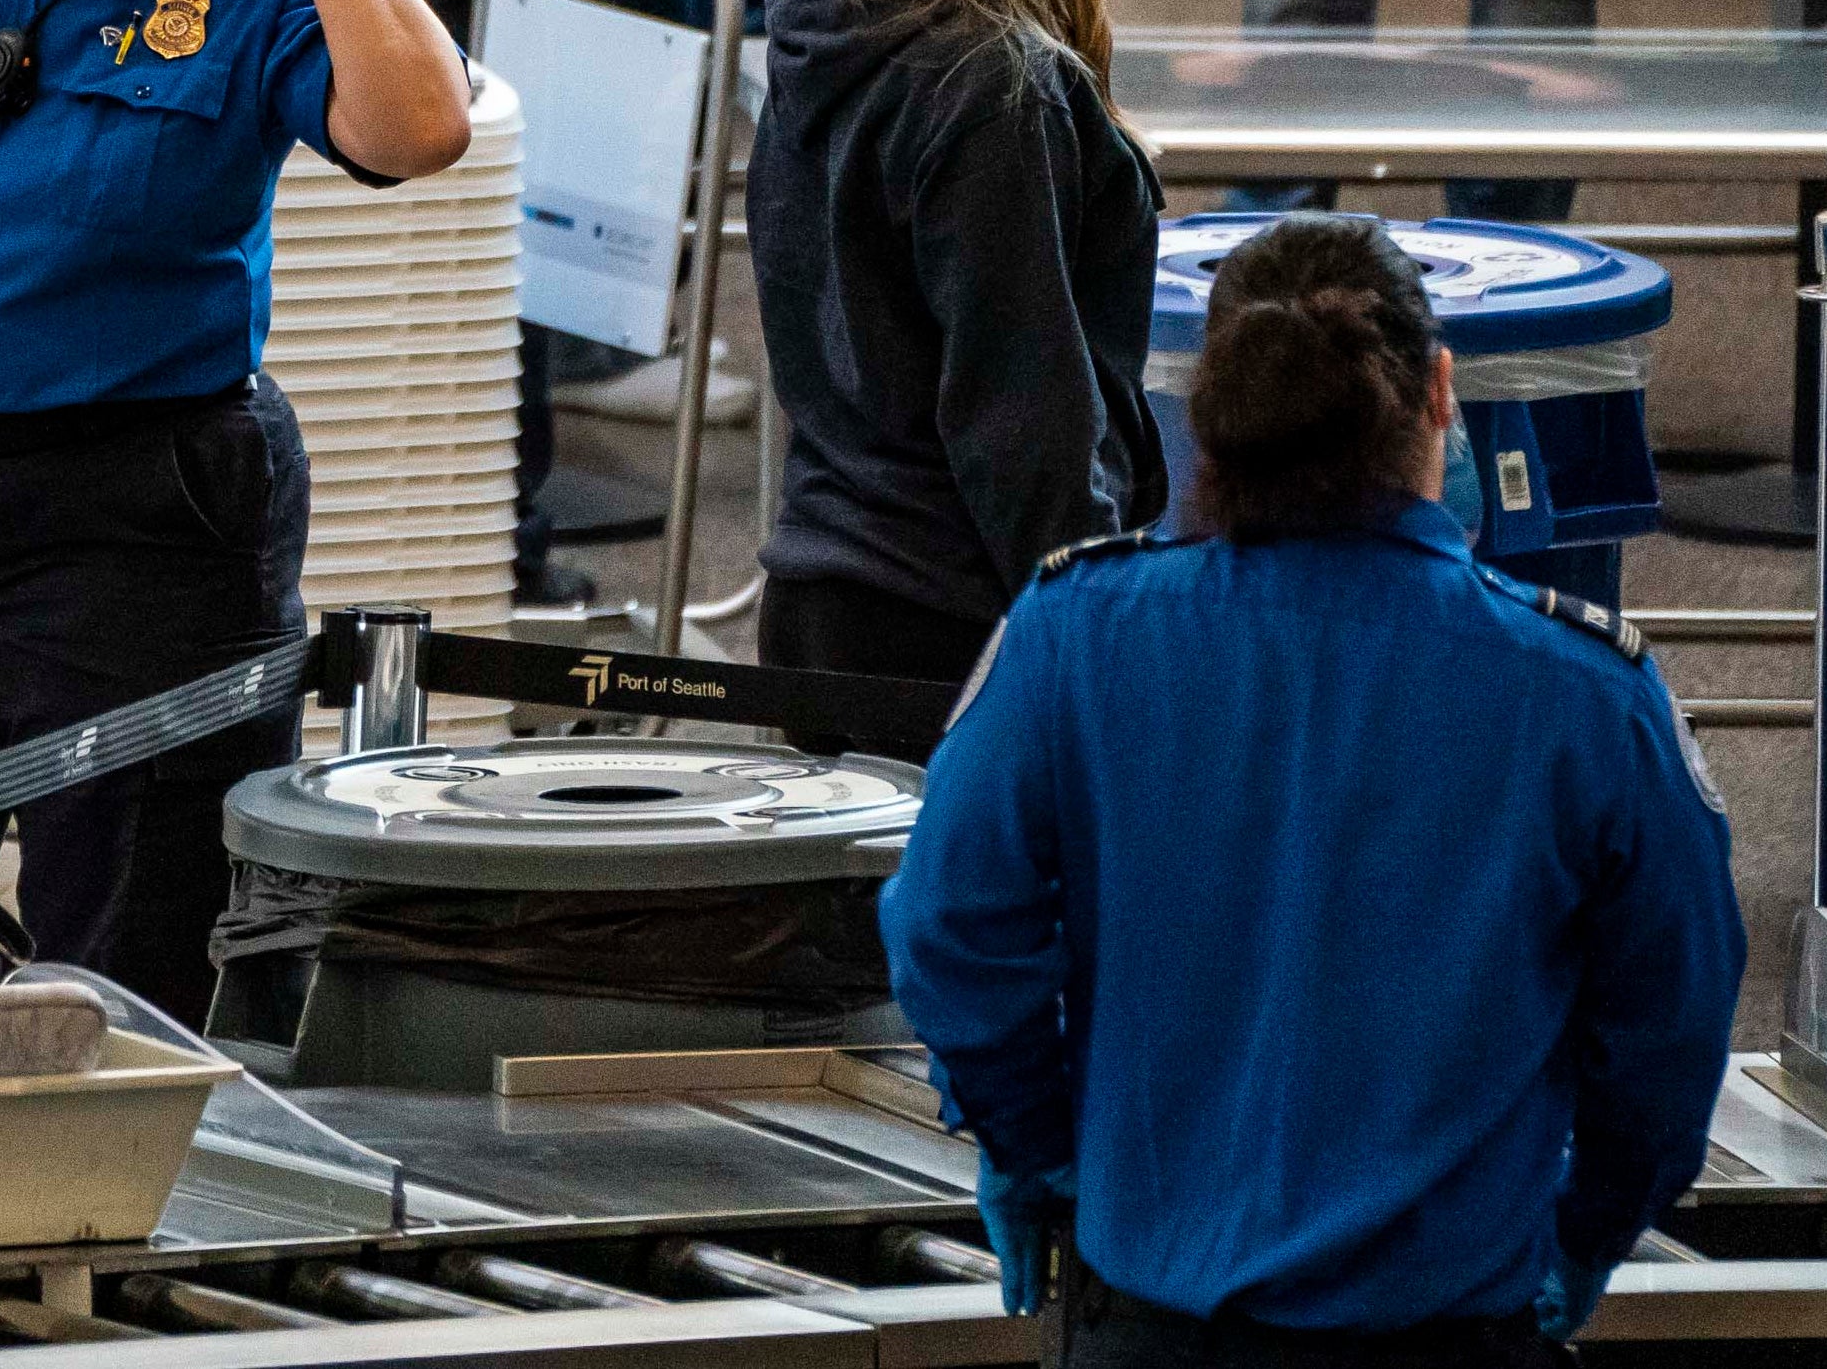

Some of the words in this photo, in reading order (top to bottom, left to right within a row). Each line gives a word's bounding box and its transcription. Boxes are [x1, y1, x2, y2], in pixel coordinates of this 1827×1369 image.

[618, 673, 650, 692] Port
[653, 677, 668, 693] of
[672, 678, 727, 699] Seattle
